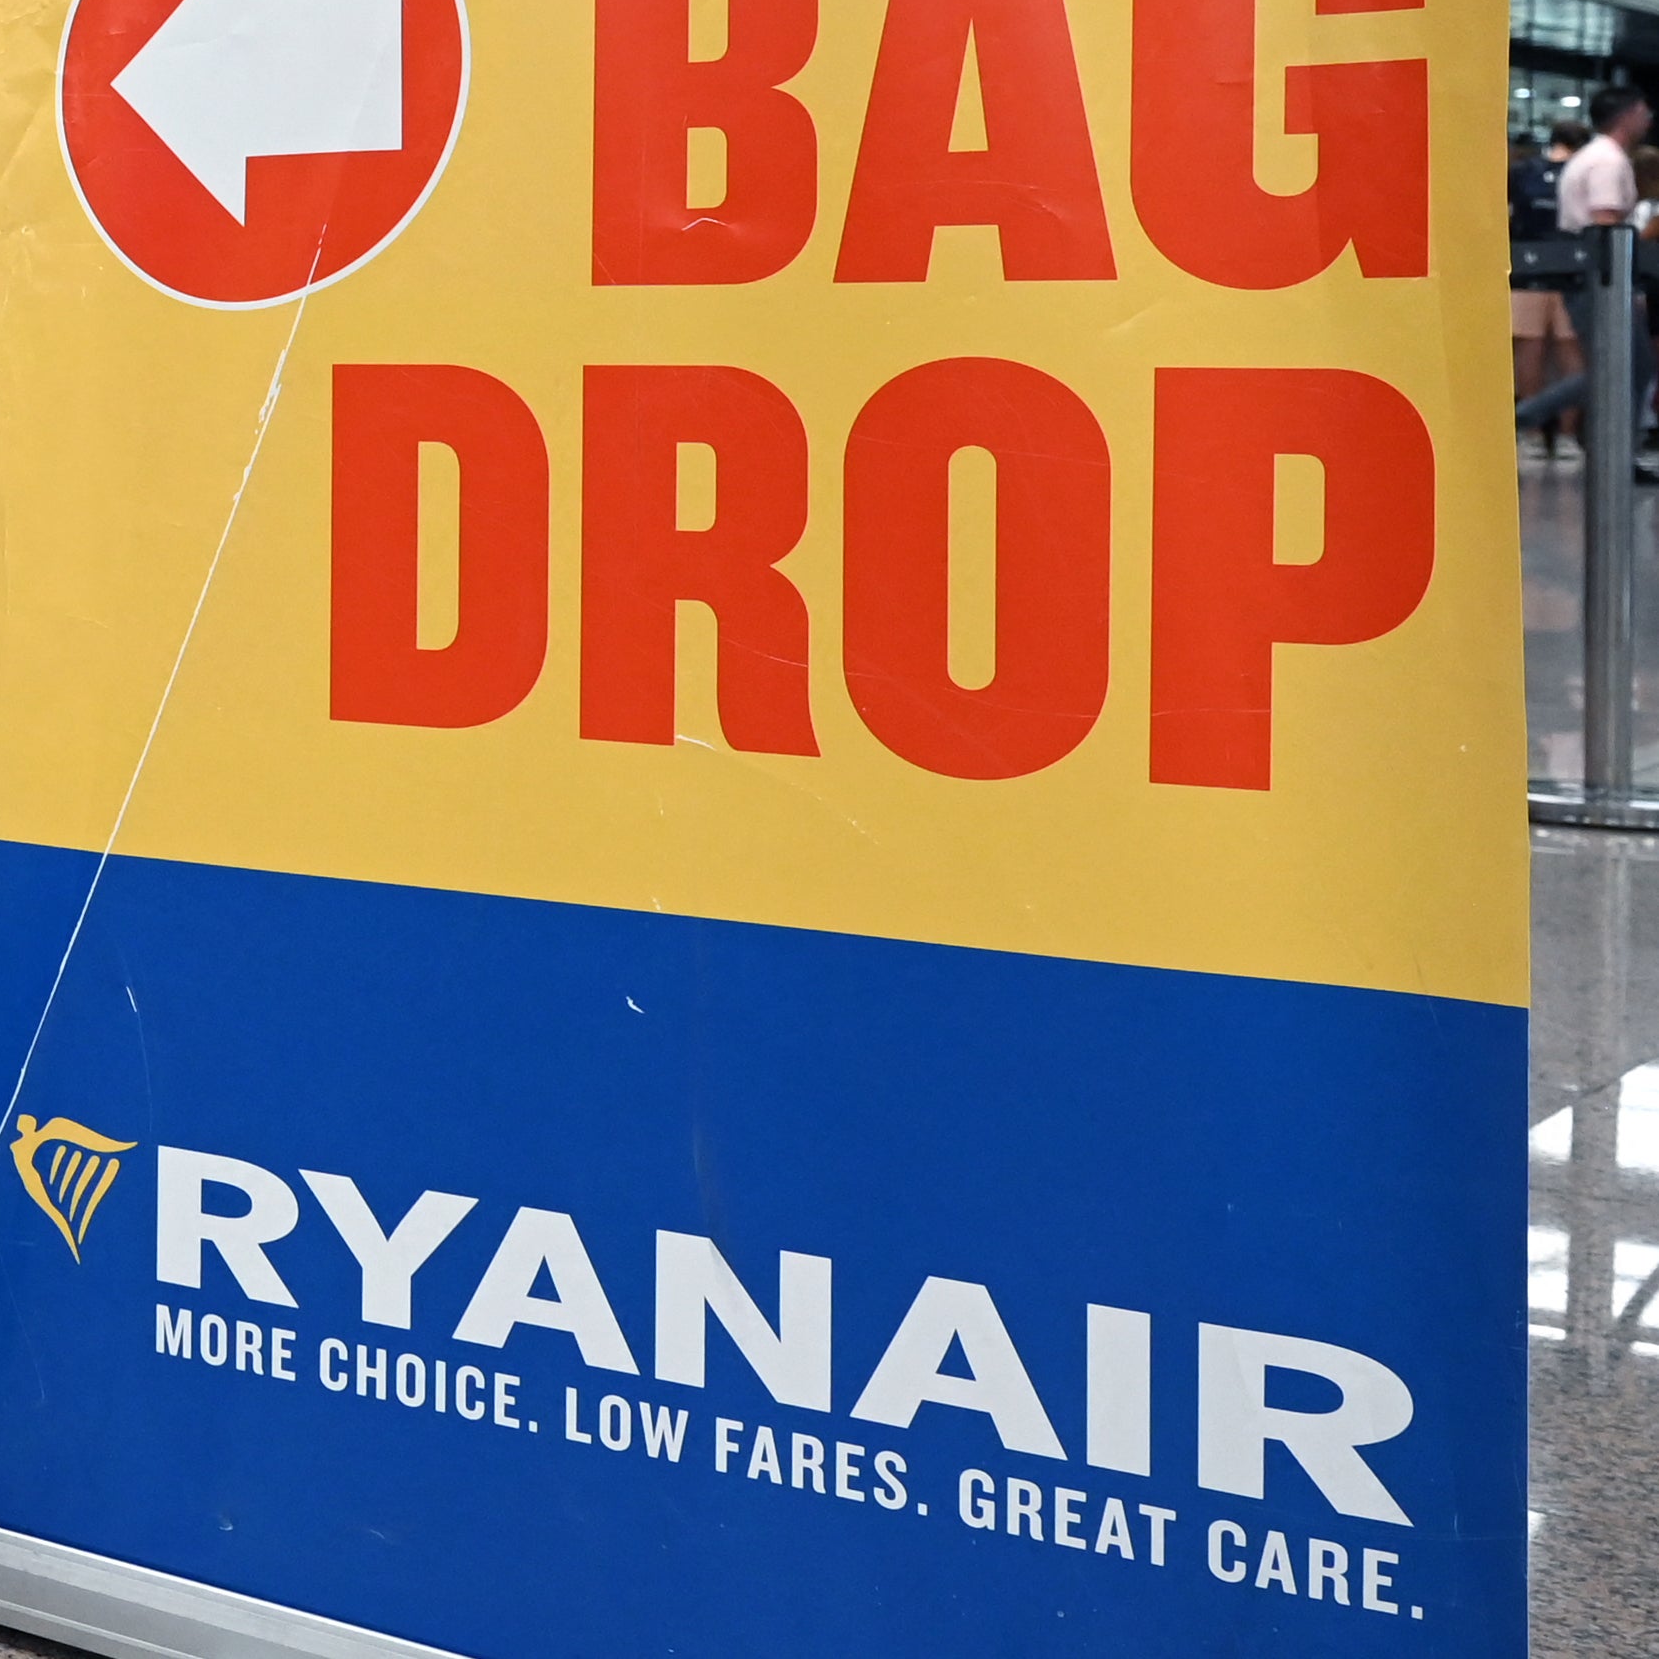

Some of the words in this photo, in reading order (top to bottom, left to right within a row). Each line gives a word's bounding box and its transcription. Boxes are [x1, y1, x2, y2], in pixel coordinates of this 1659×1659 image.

[329, 356, 1436, 793] DROP
[154, 1303, 297, 1382] MORE
[318, 1337, 539, 1433] CHOICE.
[564, 1386, 689, 1463] LOW
[714, 1417, 929, 1517] FARES.
[959, 1468, 1178, 1566] GREAT
[1207, 1519, 1424, 1621] CARE.
[155, 1144, 1414, 1528] RYANAIR
